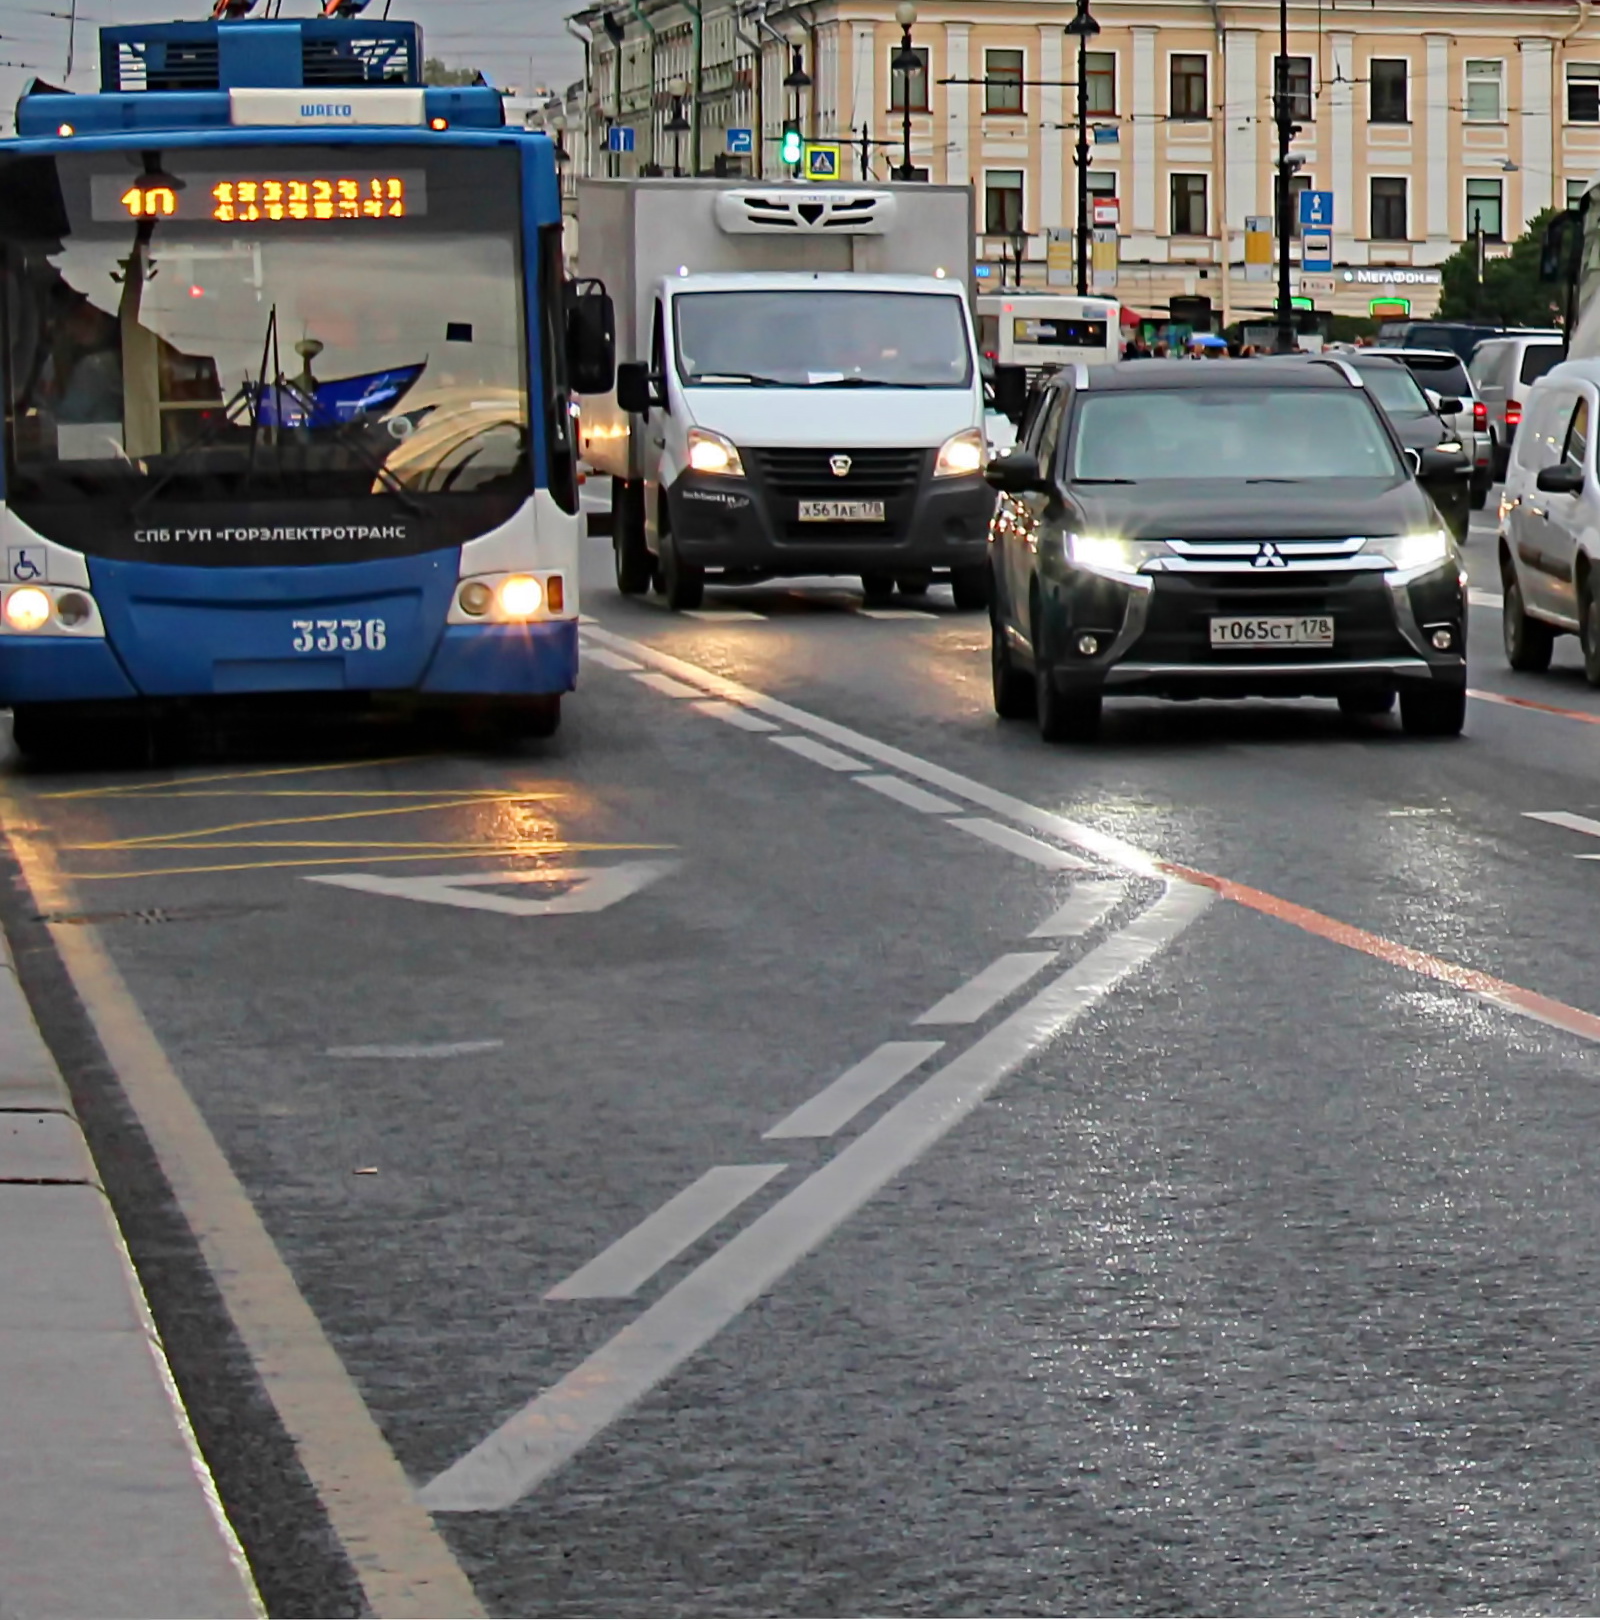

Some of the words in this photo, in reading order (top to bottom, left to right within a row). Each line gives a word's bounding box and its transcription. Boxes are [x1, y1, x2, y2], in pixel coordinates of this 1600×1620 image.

[300, 103, 351, 117] WAECO
[134, 529, 171, 542] СПБ
[175, 529, 212, 542] ГУП
[292, 618, 387, 652] 3336
[1219, 621, 1293, 639] Т065СТ
[1301, 619, 1328, 633] 178
